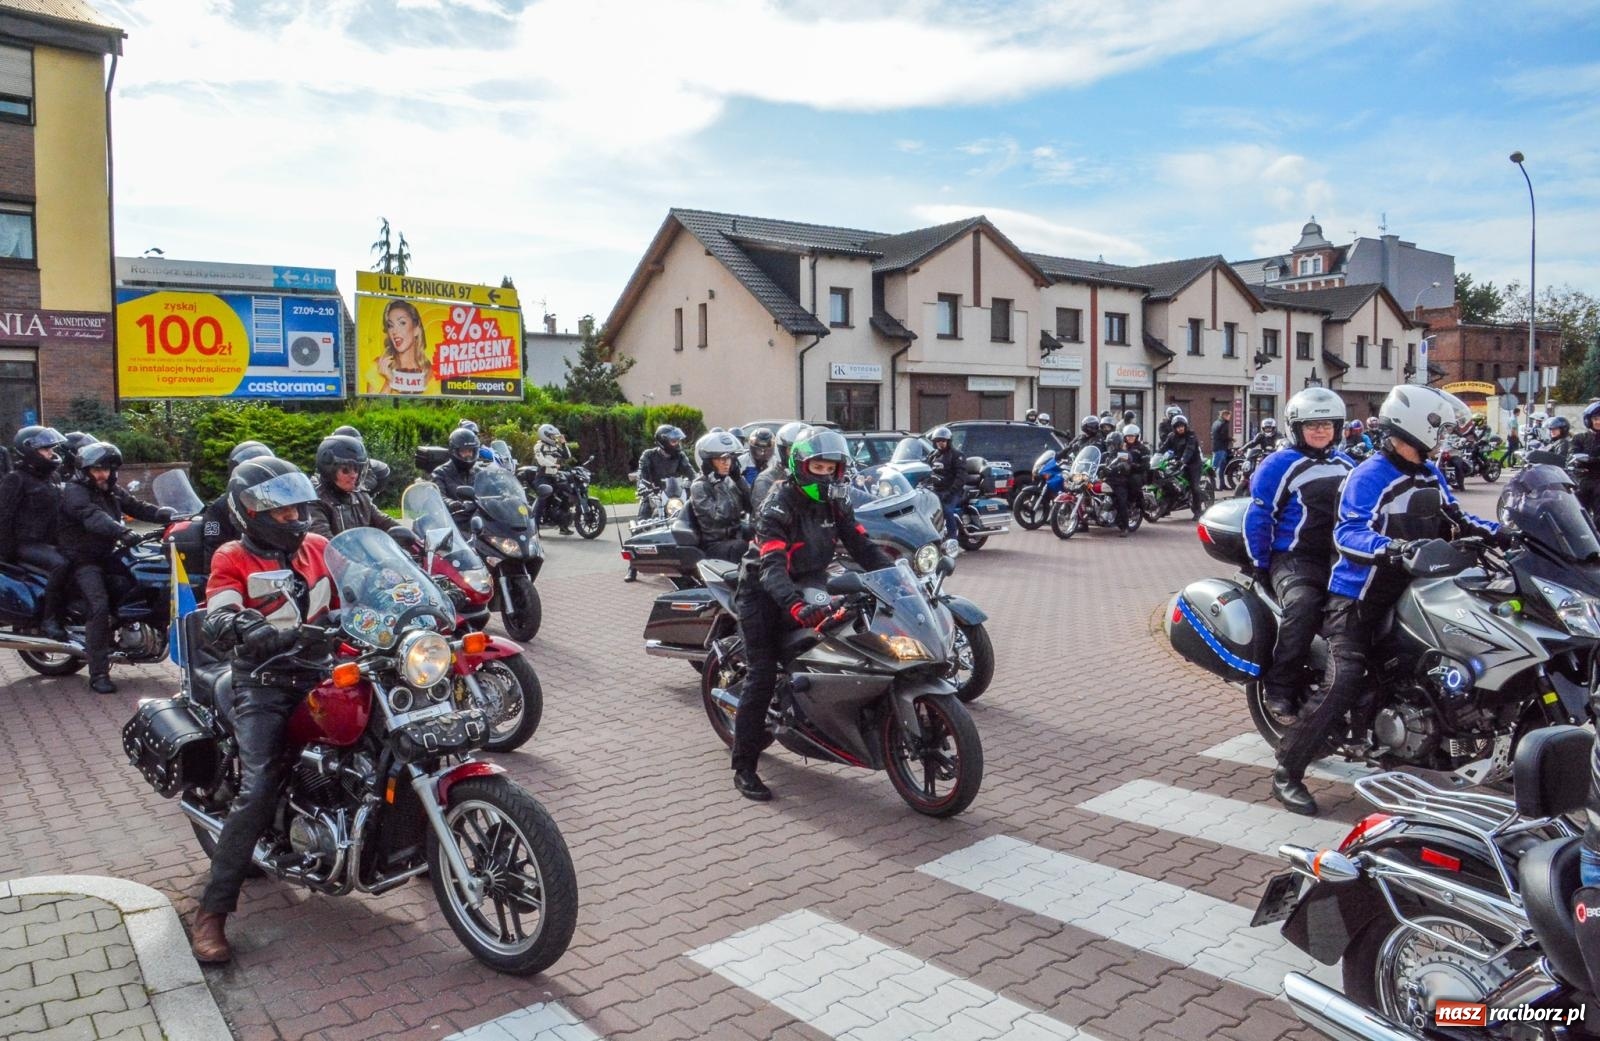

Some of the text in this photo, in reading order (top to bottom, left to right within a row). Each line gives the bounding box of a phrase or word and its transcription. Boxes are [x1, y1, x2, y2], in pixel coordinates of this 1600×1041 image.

[302, 273, 332, 284] 4 km
[378, 276, 472, 299] UL. RYBNICKA 97
[164, 302, 197, 313] zyskaj
[136, 314, 233, 356] 100 zł
[439, 338, 512, 363] PRZECENY
[140, 364, 184, 374] instalacje
[185, 365, 242, 374] hydrauliczne
[439, 355, 512, 375] NA URODZINY!
[162, 375, 215, 384] ogrzewanie
[406, 377, 421, 386] LAT
[248, 380, 326, 393] castorama
[447, 380, 506, 392] mediaexpert
[204, 521, 220, 536] 23
